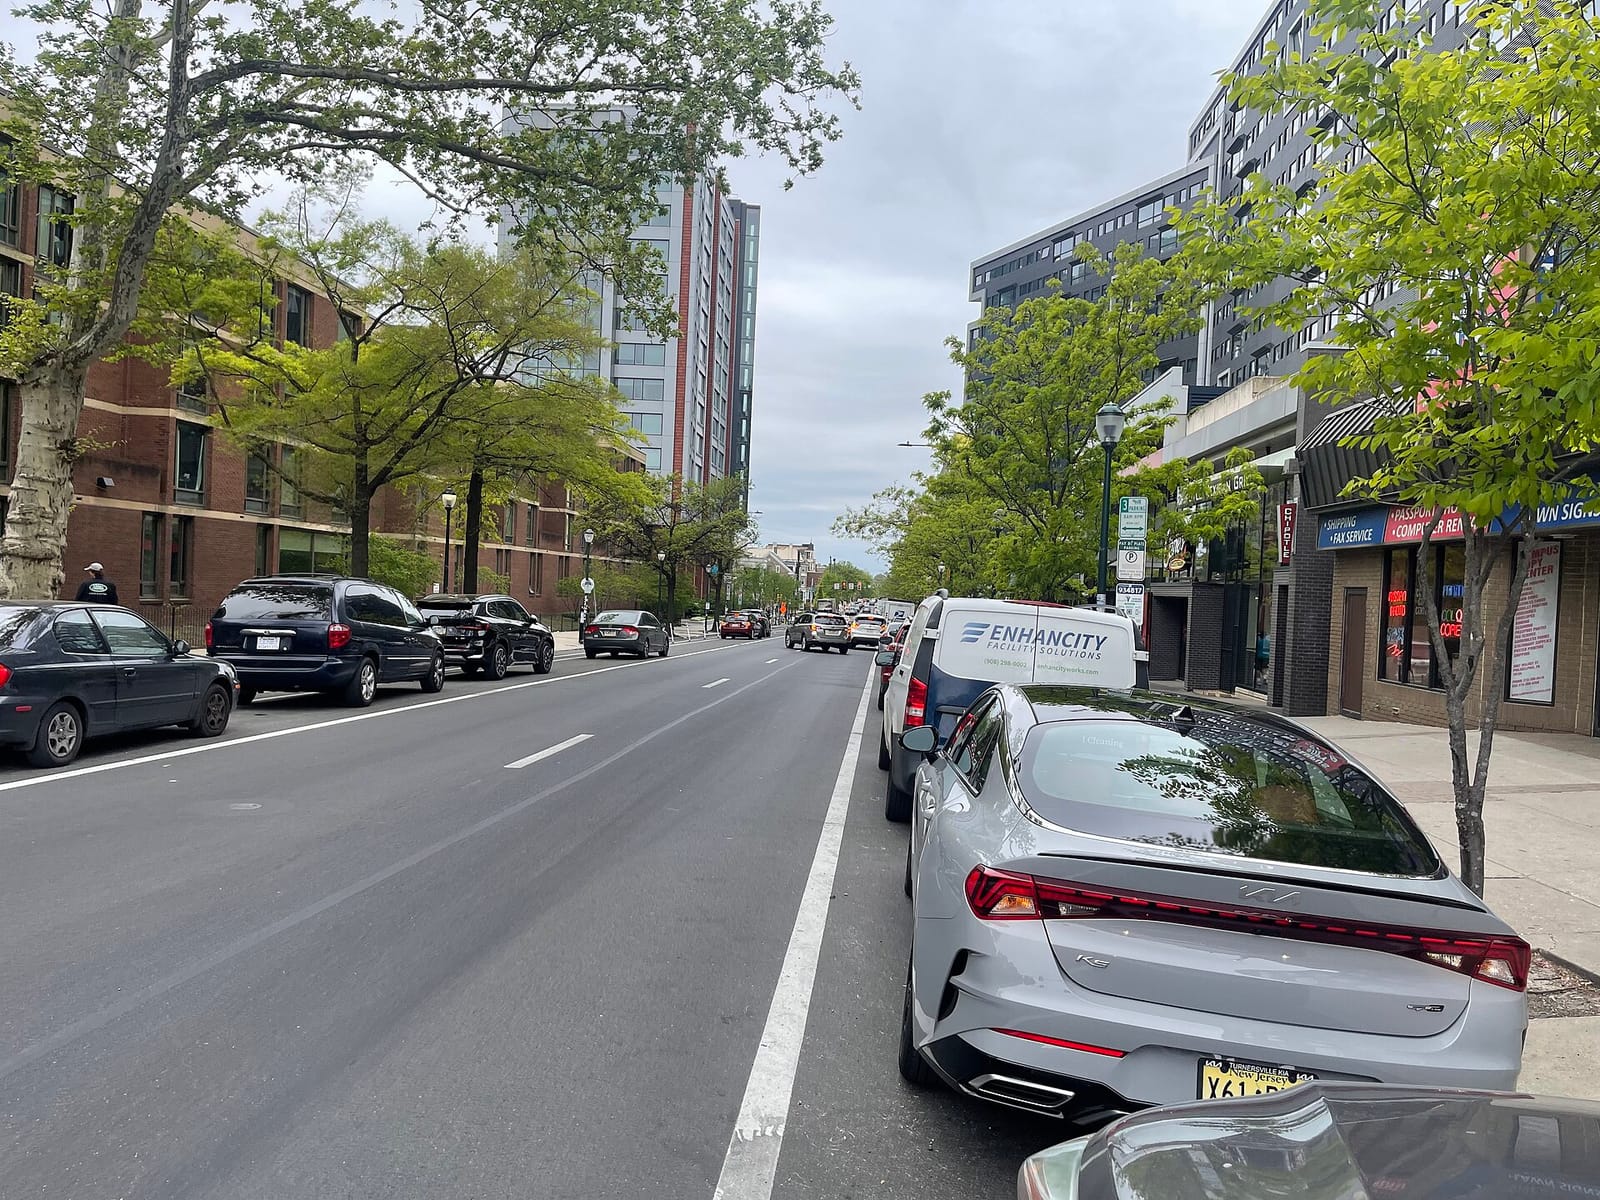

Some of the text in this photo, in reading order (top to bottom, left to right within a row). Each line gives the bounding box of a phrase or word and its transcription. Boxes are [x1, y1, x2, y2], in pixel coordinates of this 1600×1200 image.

[1122, 499, 1128, 511] 3
[1327, 514, 1356, 530] SHIPPING
[1283, 508, 1292, 558] CHIPOTLE
[1333, 528, 1373, 545] FAX SERVICE
[990, 624, 1108, 651] ENHANCITY
[986, 641, 1102, 661] FACILITY SOLUTIONS
[1229, 1062, 1278, 1075] TURNERSVILLE
[1277, 1069, 1290, 1077] KIA
[1230, 1069, 1288, 1086] New Jersey
